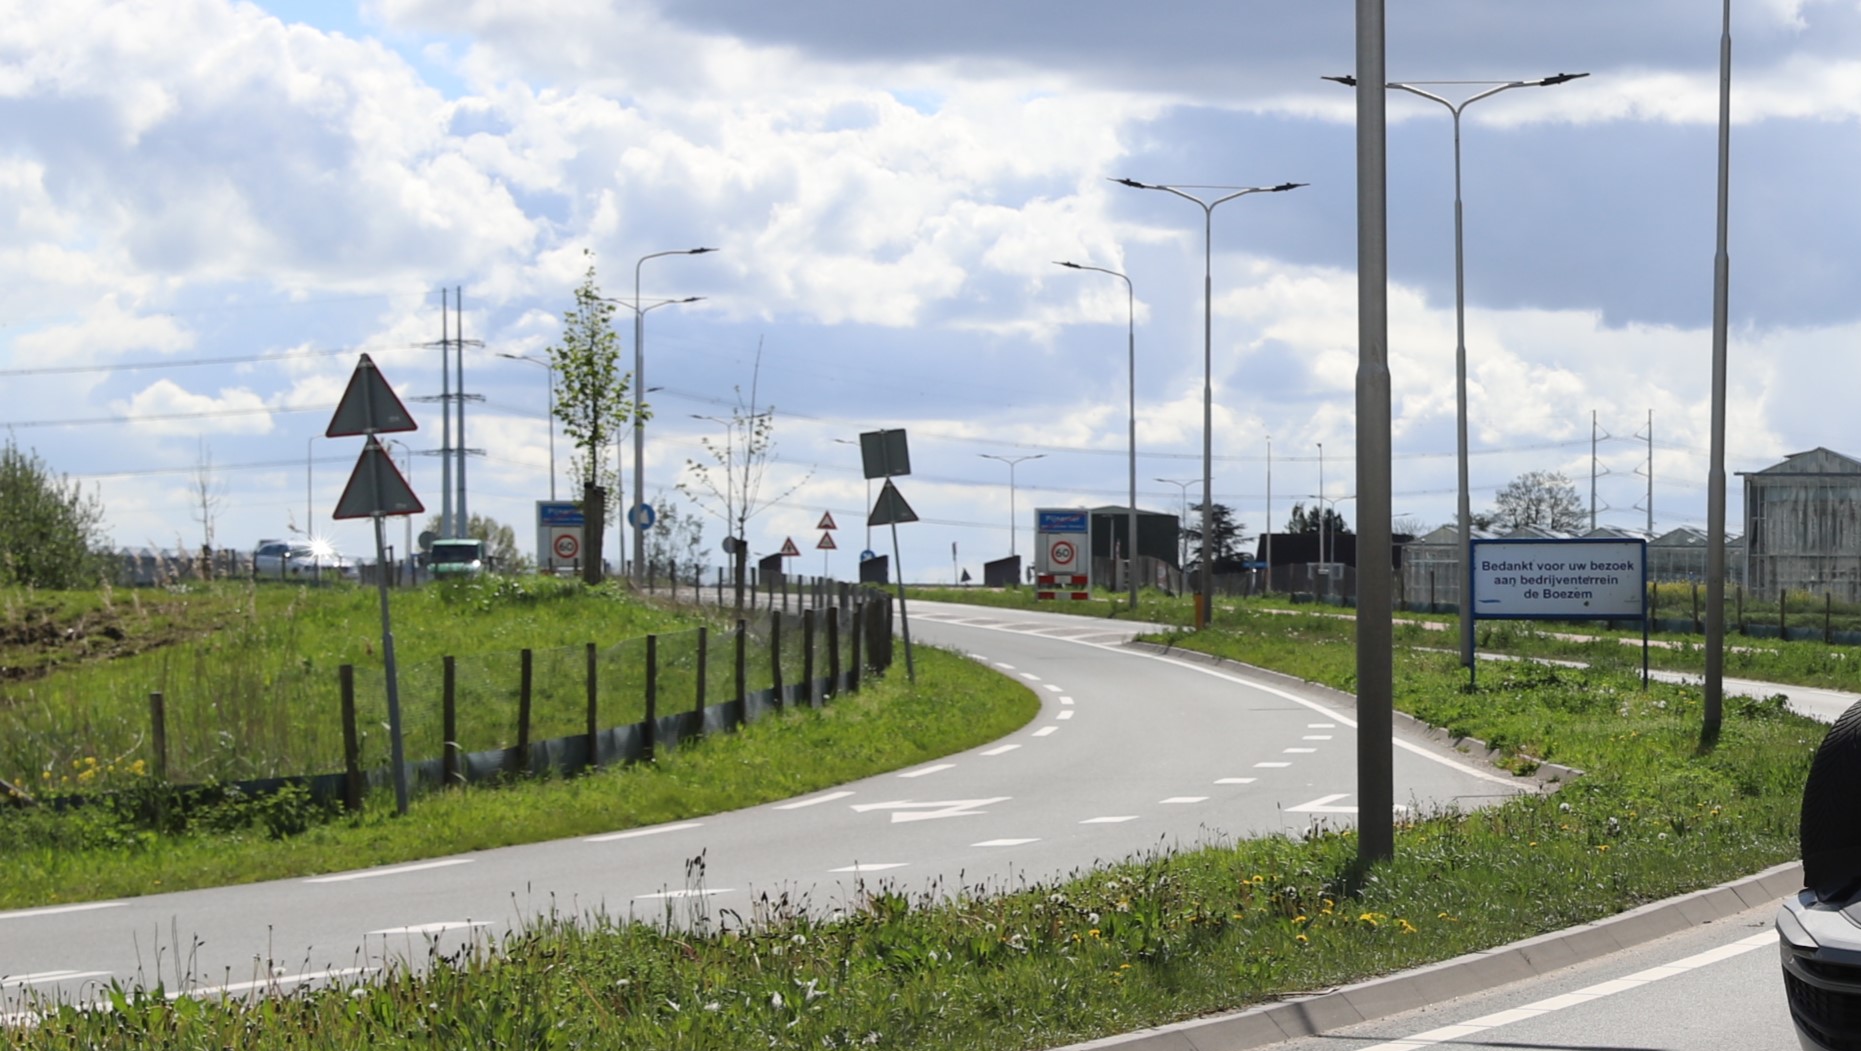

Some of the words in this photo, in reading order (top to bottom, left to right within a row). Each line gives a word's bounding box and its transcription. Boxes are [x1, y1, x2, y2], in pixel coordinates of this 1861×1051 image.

[559, 542, 574, 551] 60
[1056, 549, 1069, 557] 60
[1482, 561, 1533, 571] Bedankt
[1537, 563, 1565, 571] voor
[1590, 561, 1634, 571] bezoek
[1494, 577, 1516, 586] aan
[1520, 575, 1618, 587] bedrijventerrein
[1524, 589, 1539, 599] de
[1543, 589, 1592, 599] Boezem
